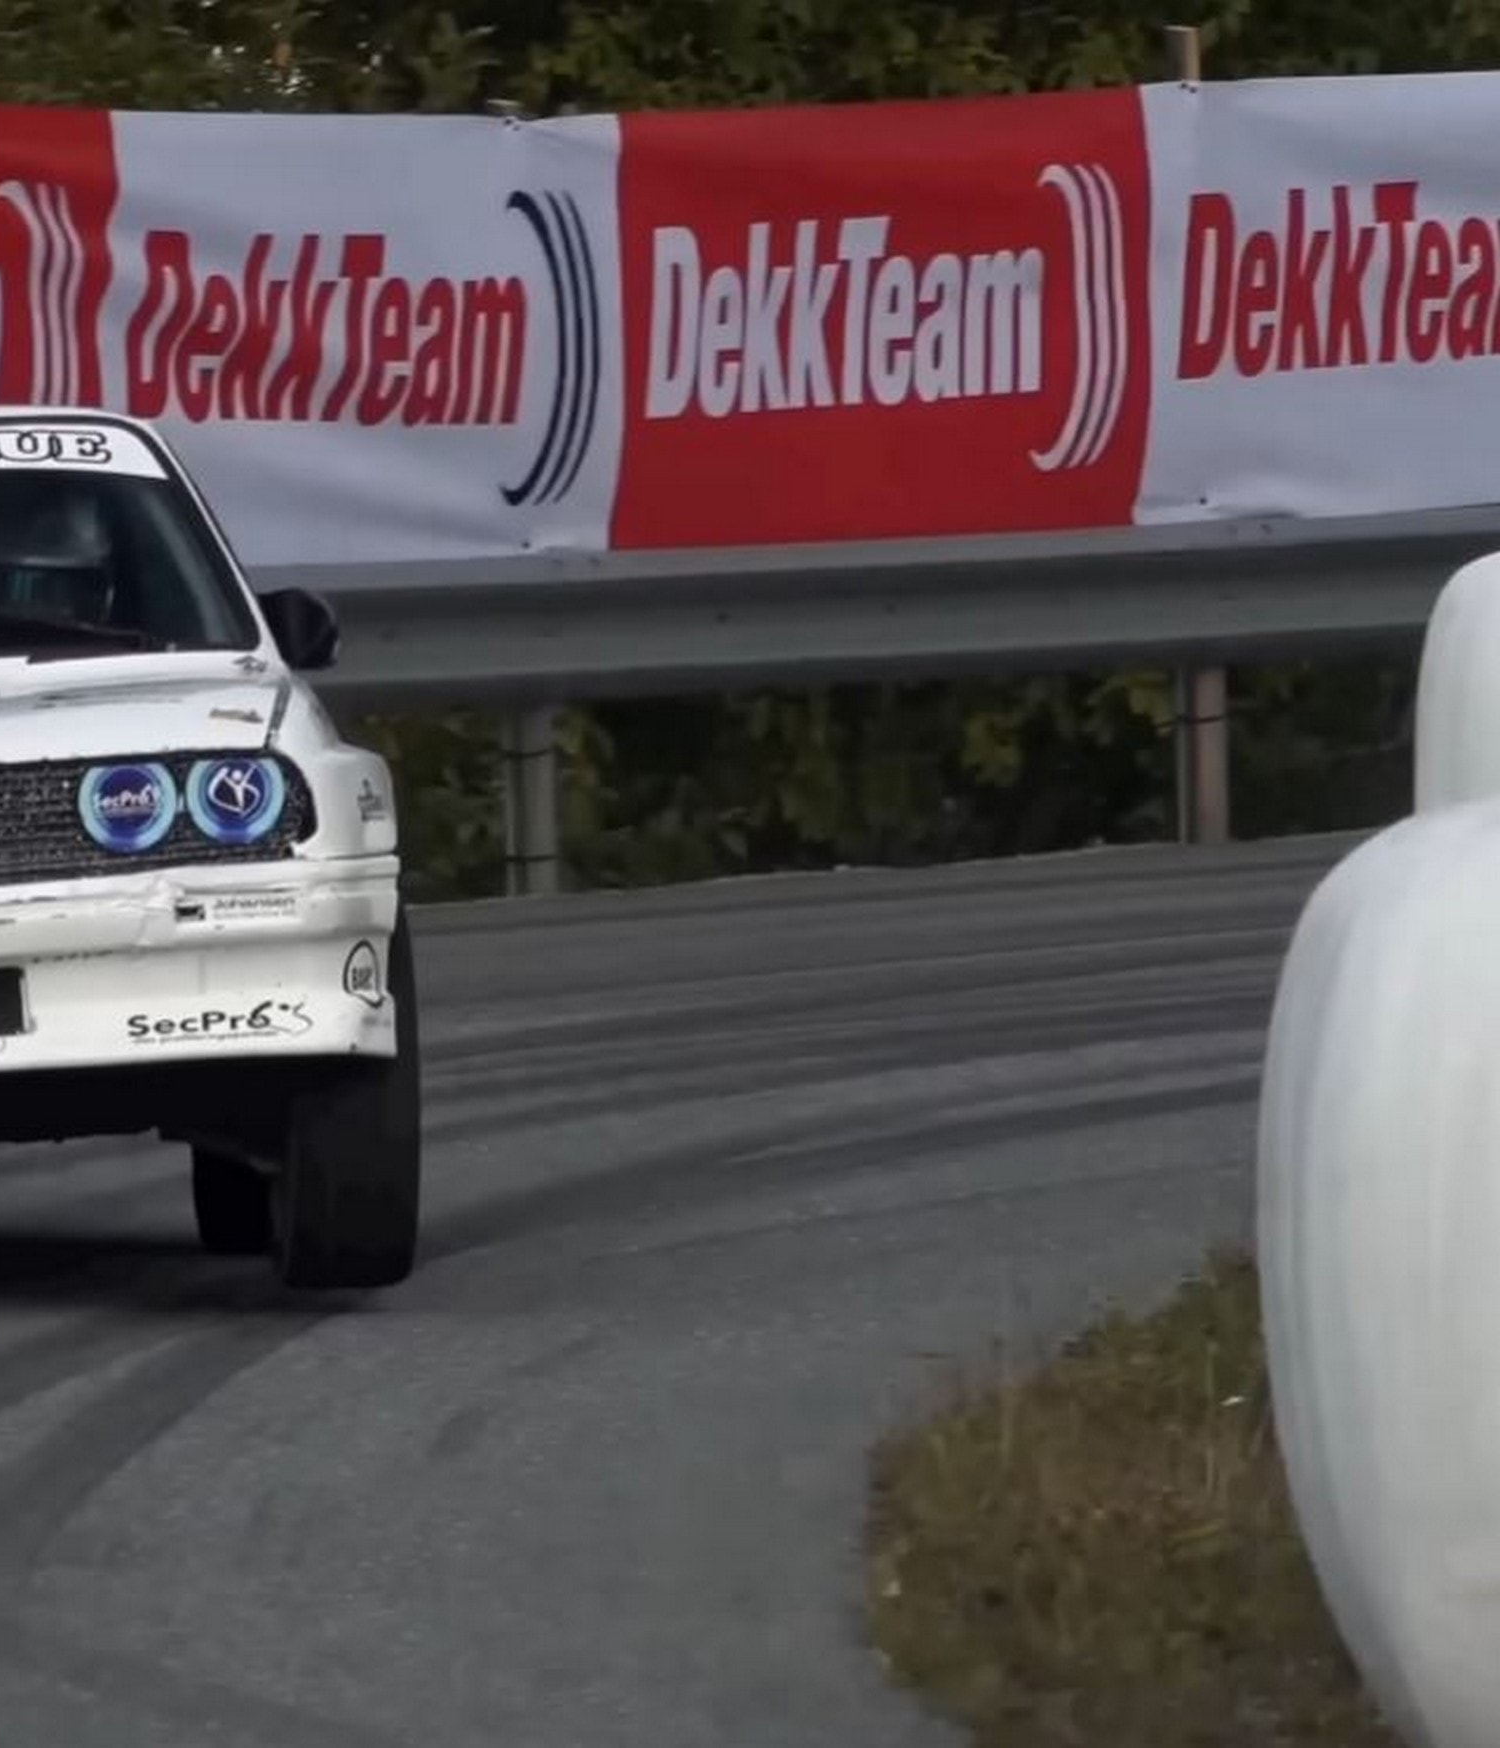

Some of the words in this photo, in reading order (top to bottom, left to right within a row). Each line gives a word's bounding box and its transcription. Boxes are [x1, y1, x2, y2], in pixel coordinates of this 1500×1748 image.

[125, 230, 527, 426] DekkTeam
[646, 216, 1042, 420] DekkTeam
[1177, 181, 1500, 379] DekkTea
